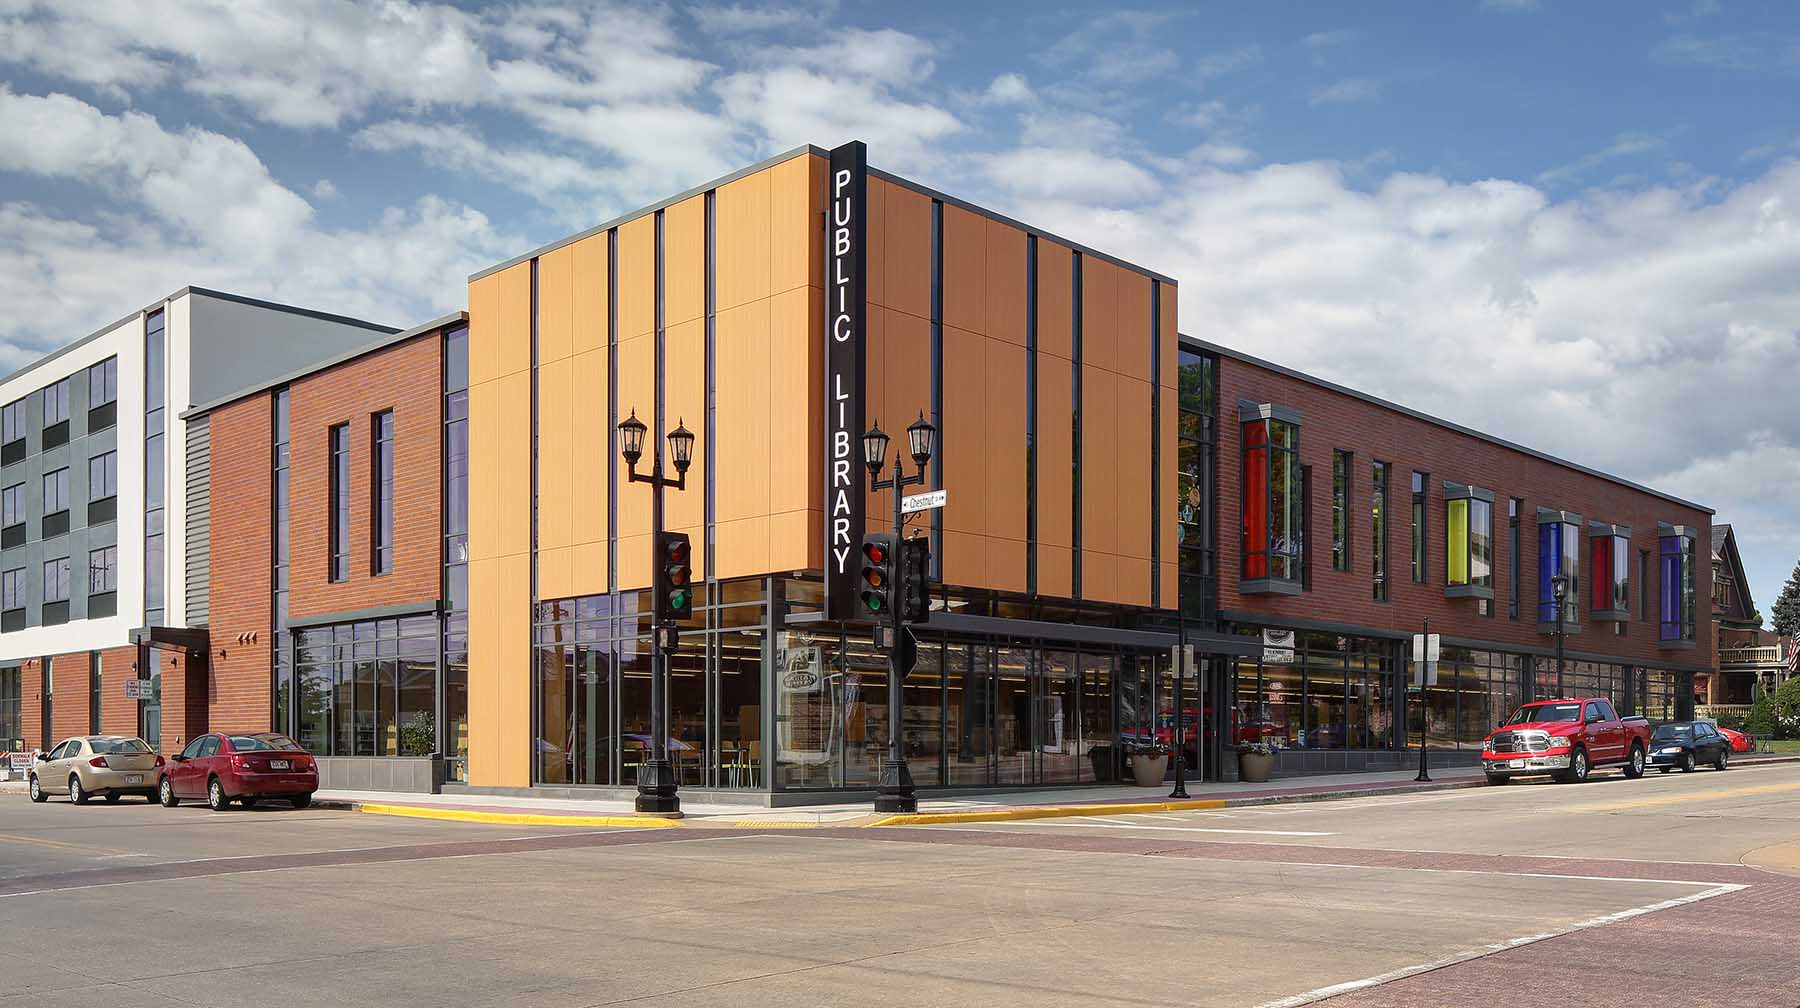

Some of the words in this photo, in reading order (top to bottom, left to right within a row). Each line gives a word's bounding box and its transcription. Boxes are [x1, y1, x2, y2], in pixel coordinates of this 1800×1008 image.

[834, 169, 851, 342] PUBLIC
[833, 373, 851, 574] LIBRARY
[910, 495, 934, 508] Chestnut
